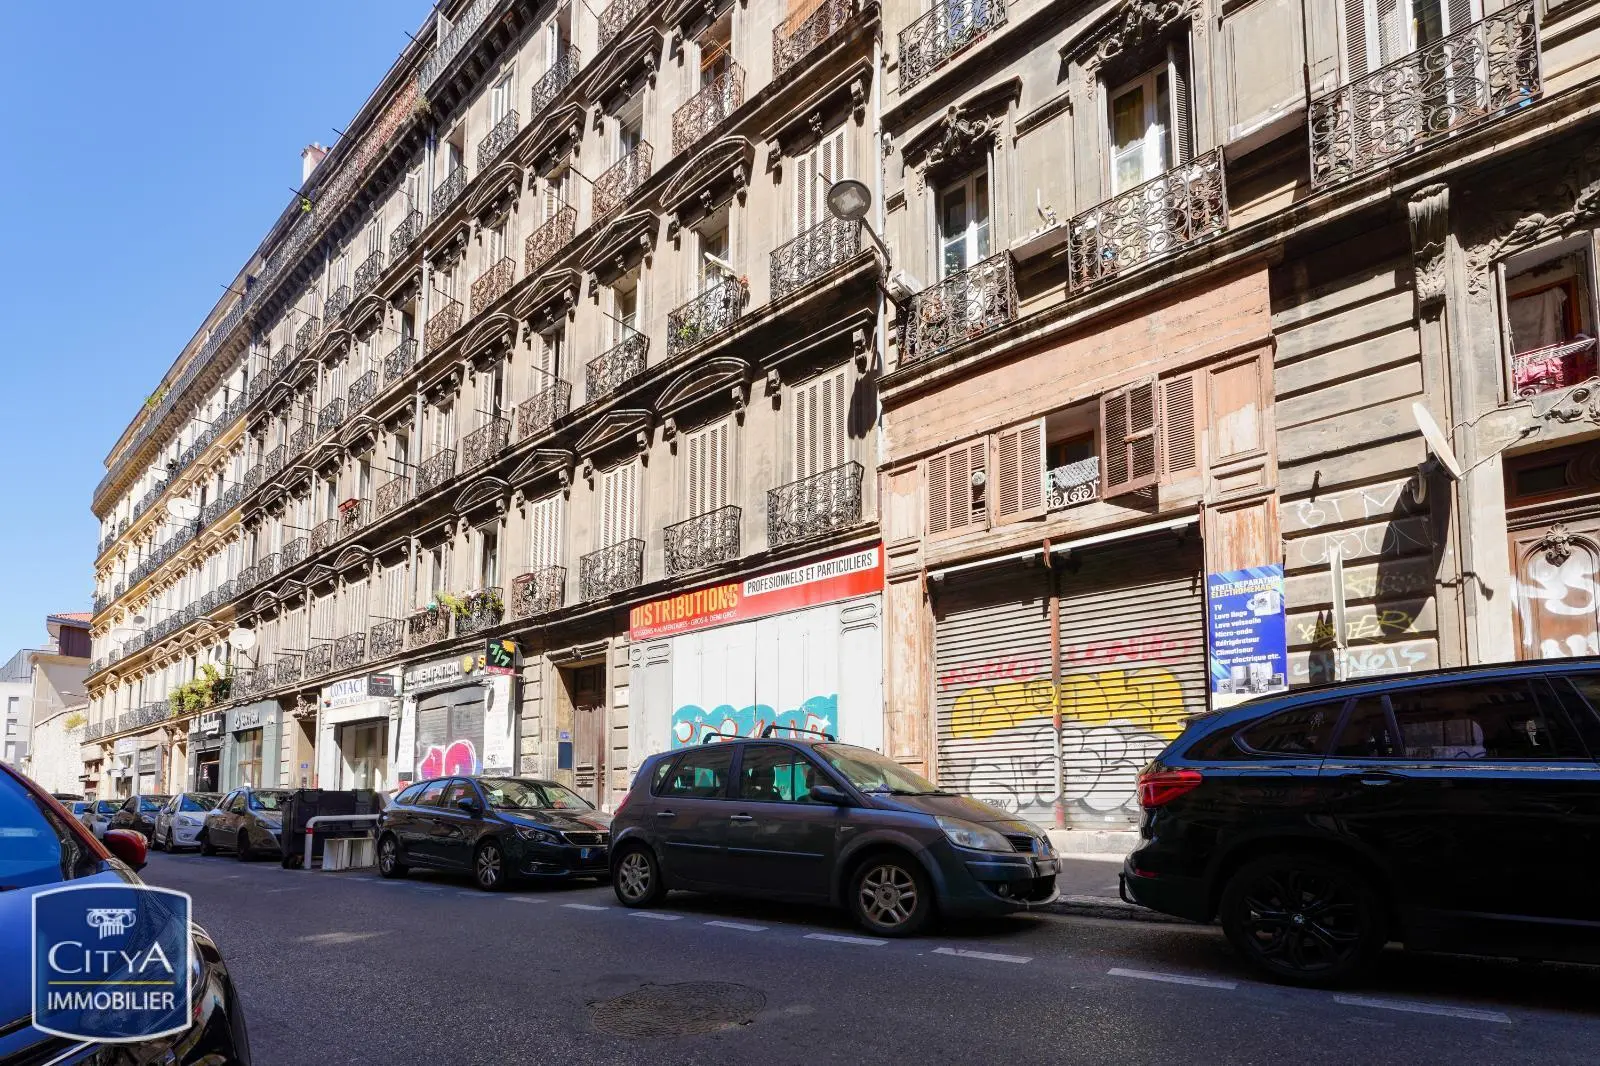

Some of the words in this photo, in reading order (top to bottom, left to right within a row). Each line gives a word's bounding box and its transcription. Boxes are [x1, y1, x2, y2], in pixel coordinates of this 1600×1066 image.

[747, 569, 804, 594] PROFESIONNELS
[806, 565, 815, 580] ET
[817, 552, 873, 578] PARTICULIERS
[1211, 583, 1233, 592] VENTE
[632, 583, 739, 628] DISTRIBUTIONS
[489, 643, 511, 667] 7/7
[405, 660, 460, 684] ALIMENTATION
